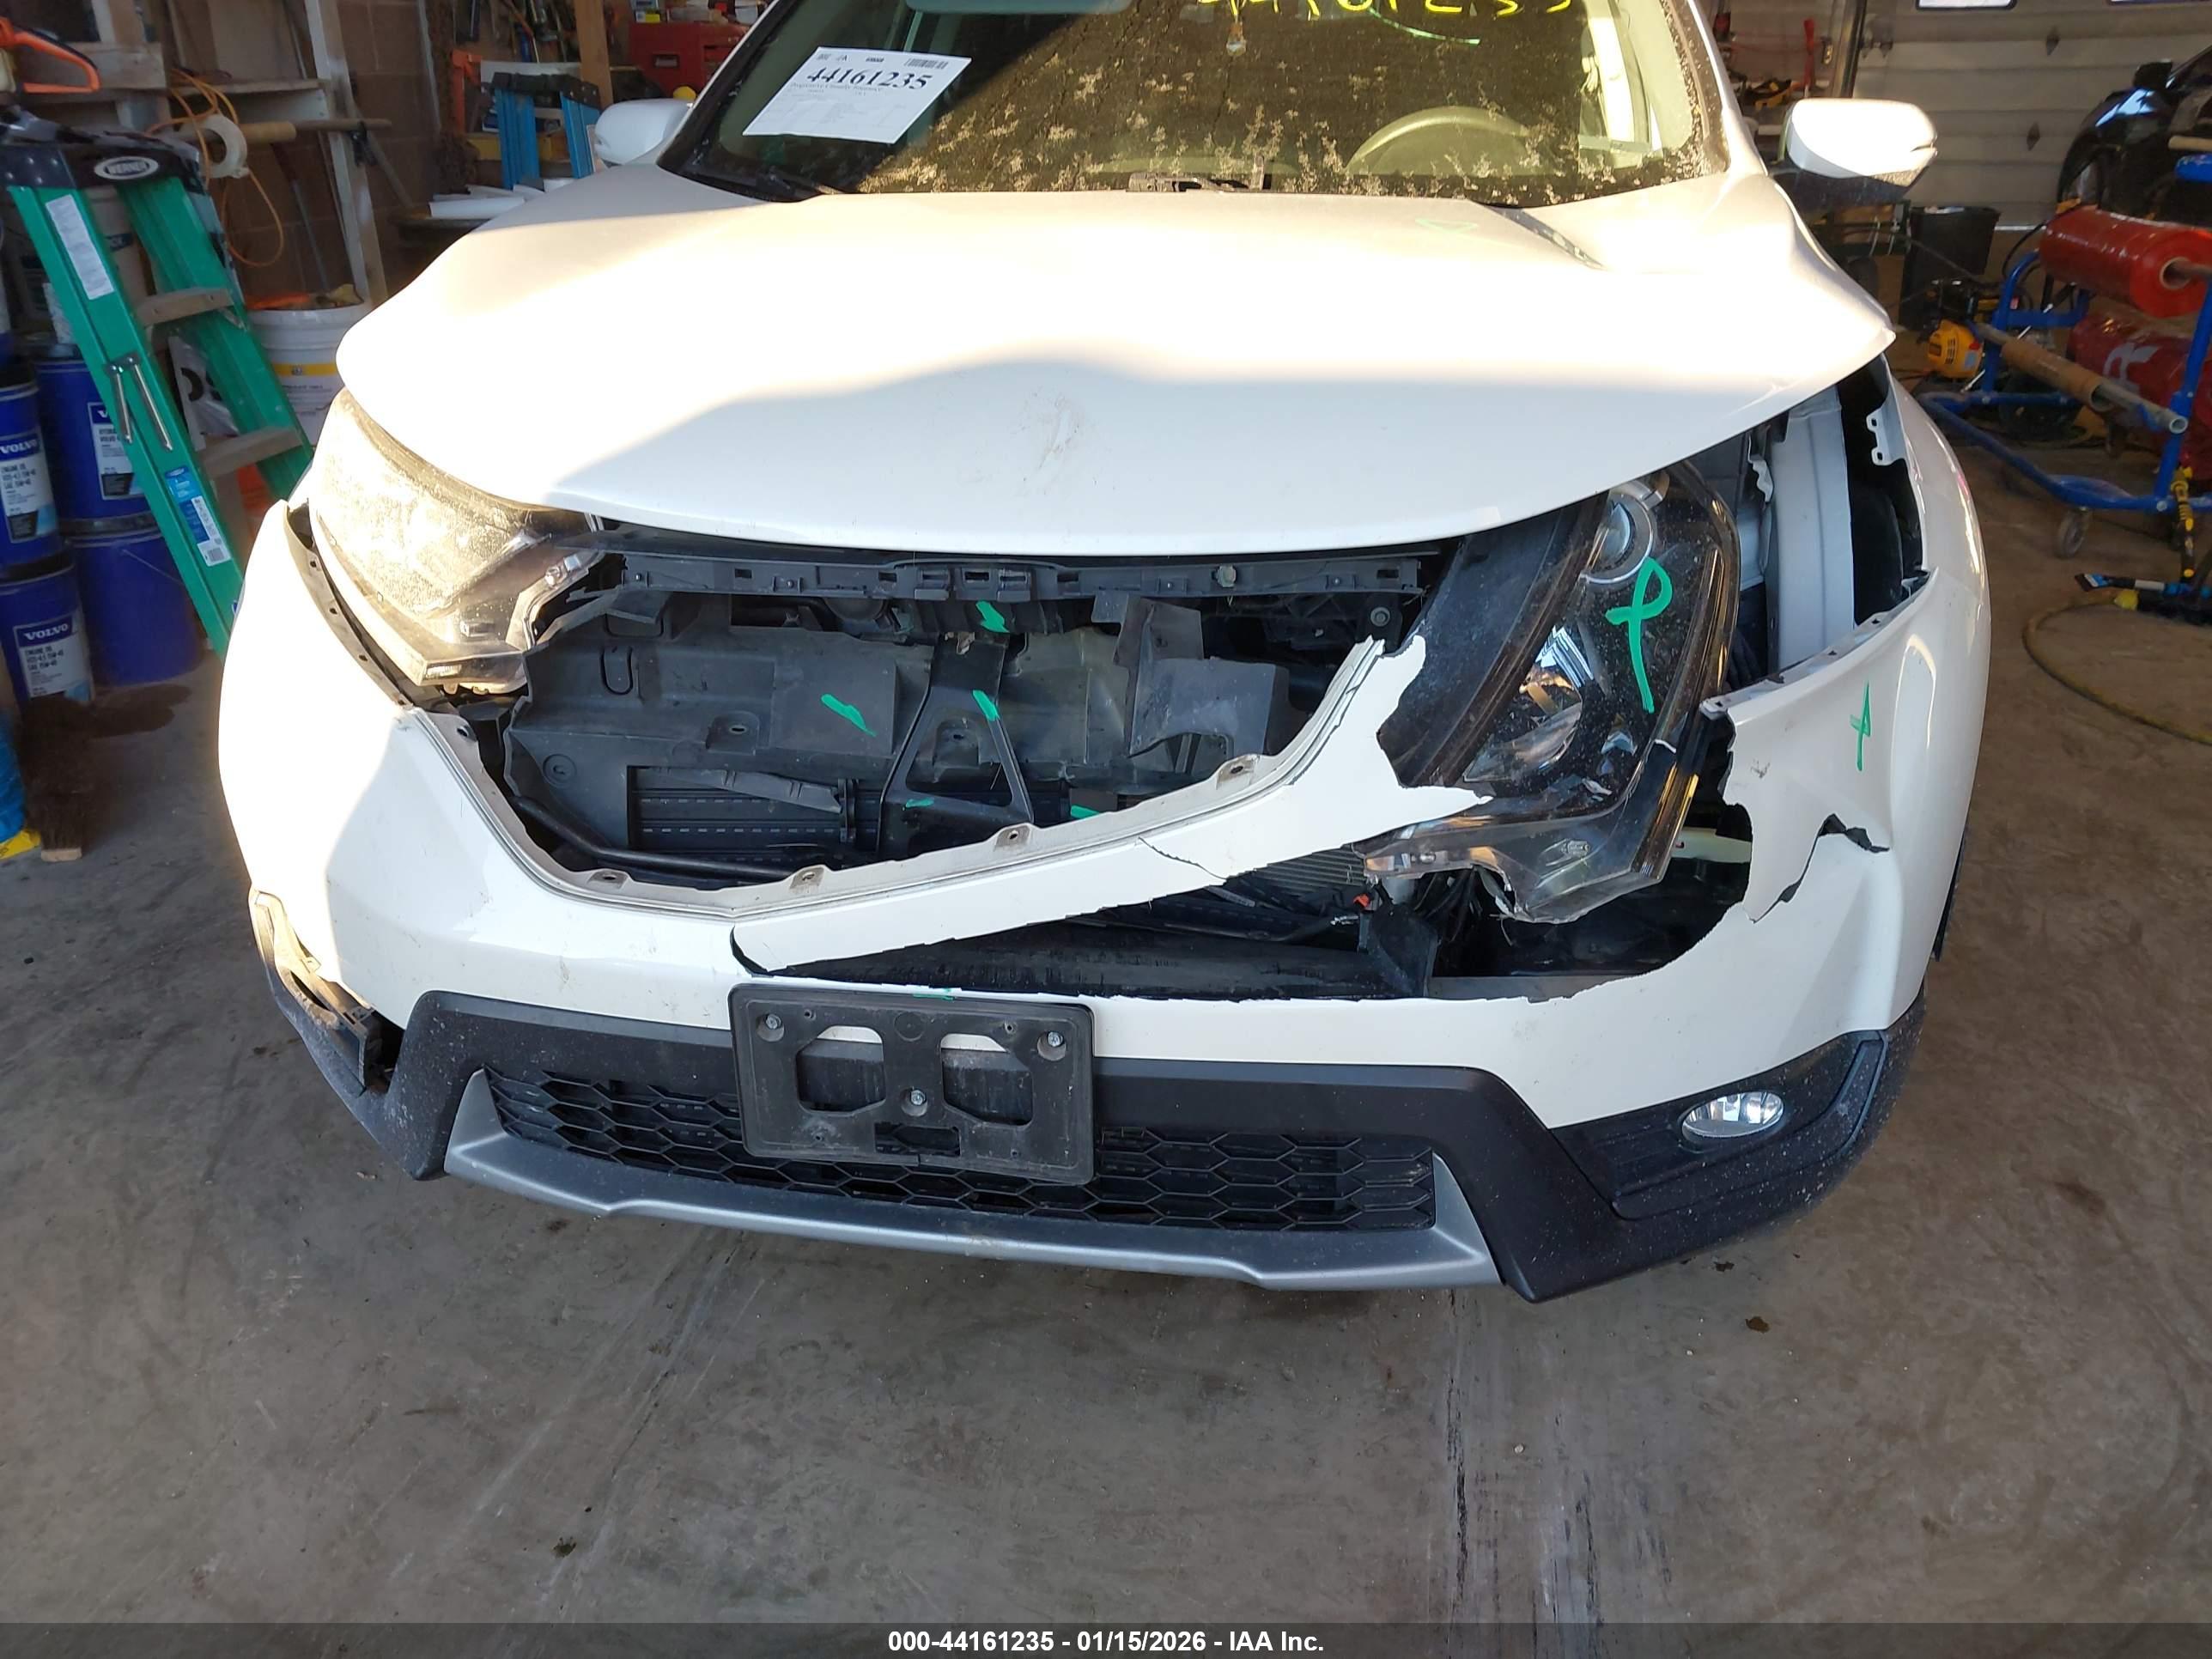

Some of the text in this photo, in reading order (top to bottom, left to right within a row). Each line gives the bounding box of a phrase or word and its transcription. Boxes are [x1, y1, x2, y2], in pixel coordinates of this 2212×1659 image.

[807, 66, 933, 90] 44161235
[0, 439, 37, 454] VOLVO
[23, 623, 69, 641] VOLVO
